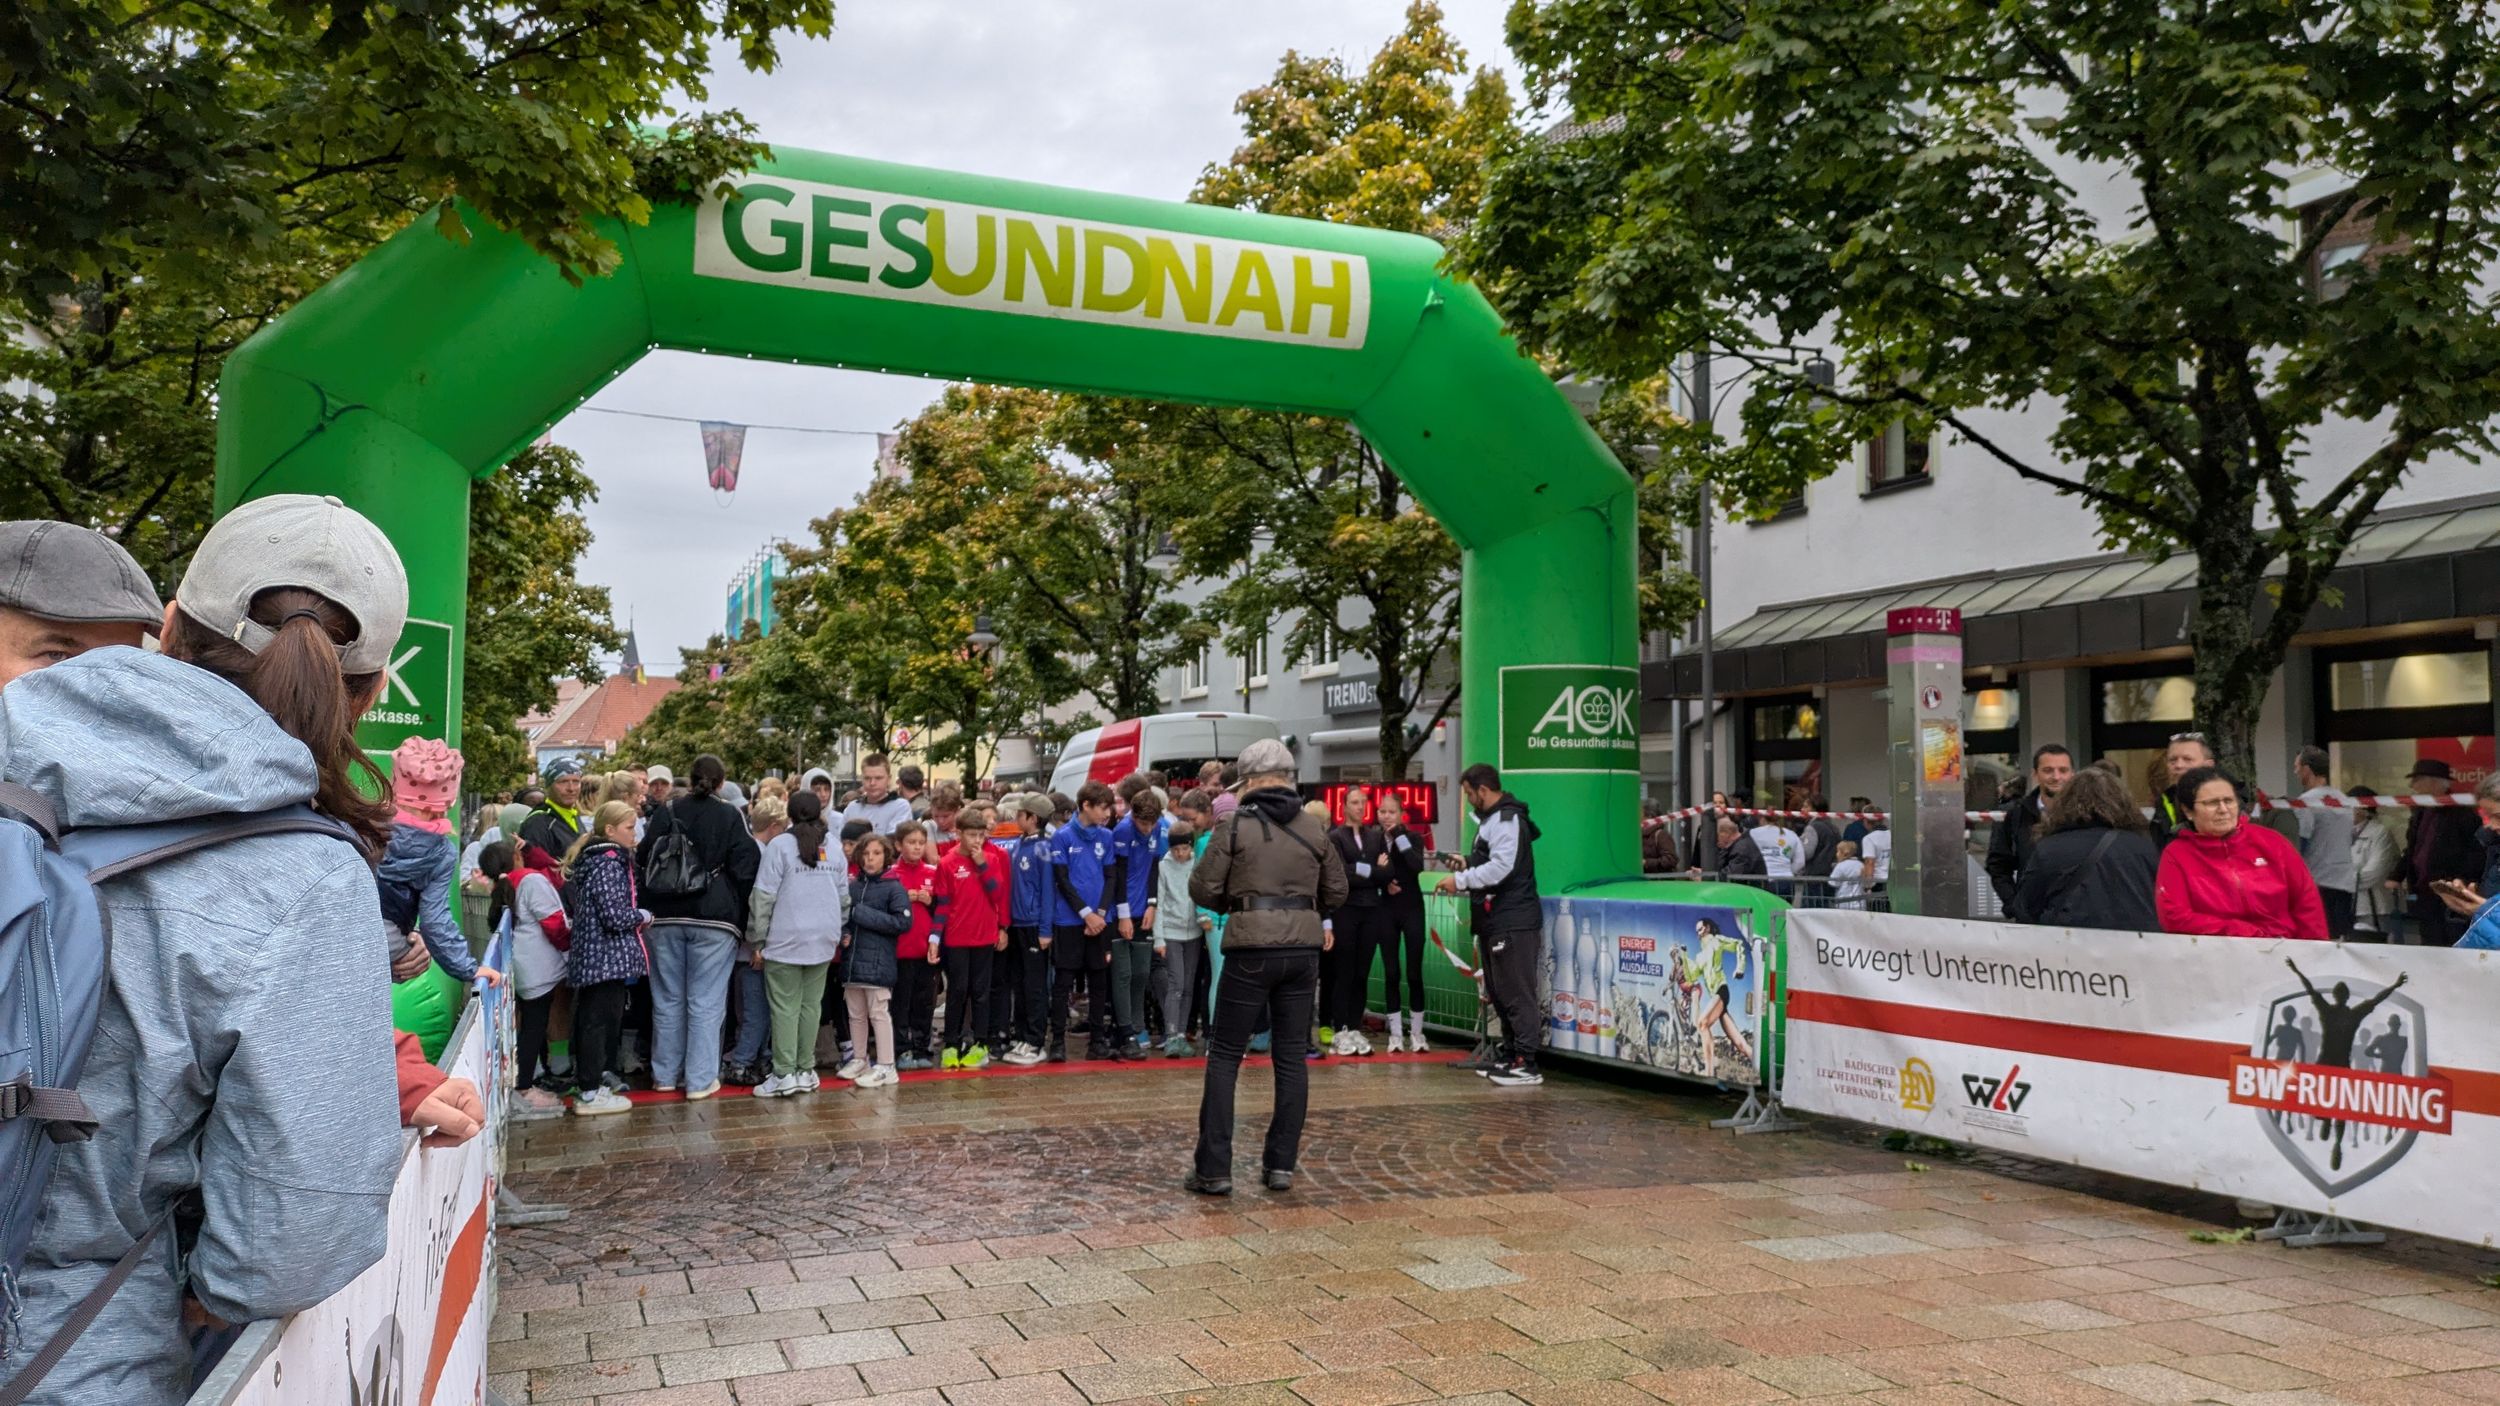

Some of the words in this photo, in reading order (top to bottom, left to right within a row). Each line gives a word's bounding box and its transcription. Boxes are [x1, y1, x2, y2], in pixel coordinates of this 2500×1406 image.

[721, 182, 1353, 340] GESUNDNAH
[379, 645, 423, 707] K
[1326, 681, 1377, 708] TRENDST
[360, 708, 424, 725] tskasse.
[1531, 685, 1636, 735] AOK
[1528, 736, 1547, 749] Die
[1550, 736, 1636, 750] Gesundheiskasse.
[1620, 937, 1654, 950] ENERGIE
[1621, 950, 1645, 962] KRAFT
[1621, 962, 1662, 976] AUSDAUER
[1816, 937, 1914, 982] Bewegt
[1922, 948, 2130, 999] Unternehmen
[1844, 1059, 1897, 1076] BADISCHER
[1834, 1084, 1879, 1101] VERBAND
[2235, 1064, 2445, 1125] BW-RUNNING
